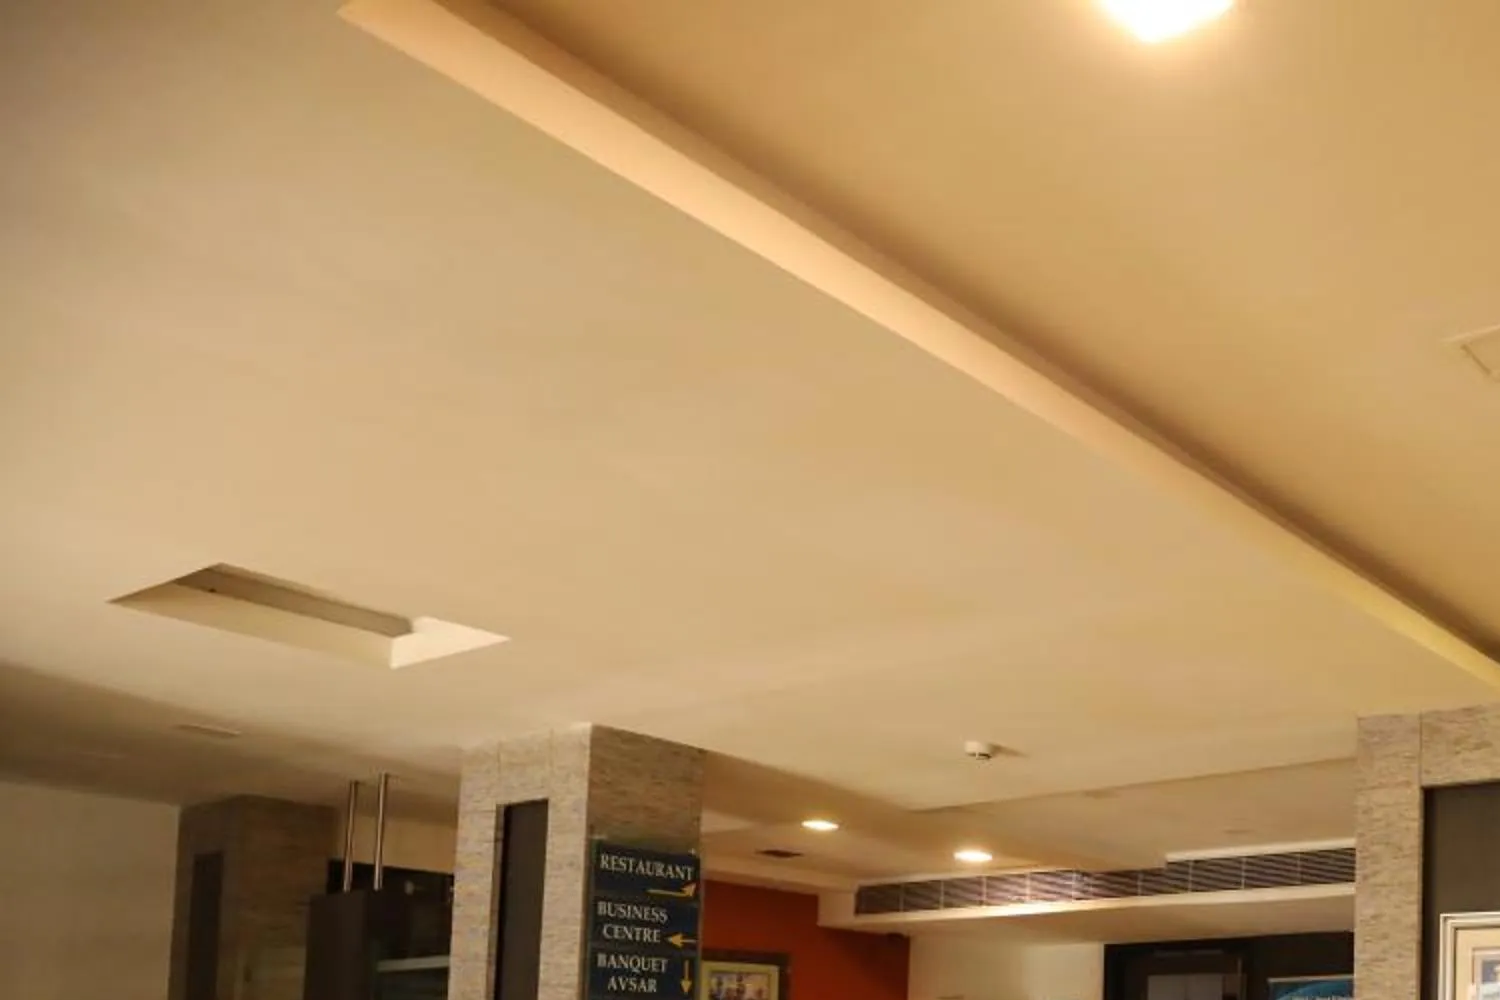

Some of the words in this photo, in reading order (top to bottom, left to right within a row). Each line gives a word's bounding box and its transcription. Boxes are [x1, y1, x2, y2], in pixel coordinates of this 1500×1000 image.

[600, 854, 694, 881] RESTAURANT
[597, 901, 669, 924] BUSINESS
[602, 924, 661, 943] CENTRE
[597, 953, 668, 974] BANQUET
[607, 977, 657, 993] AVSAR
